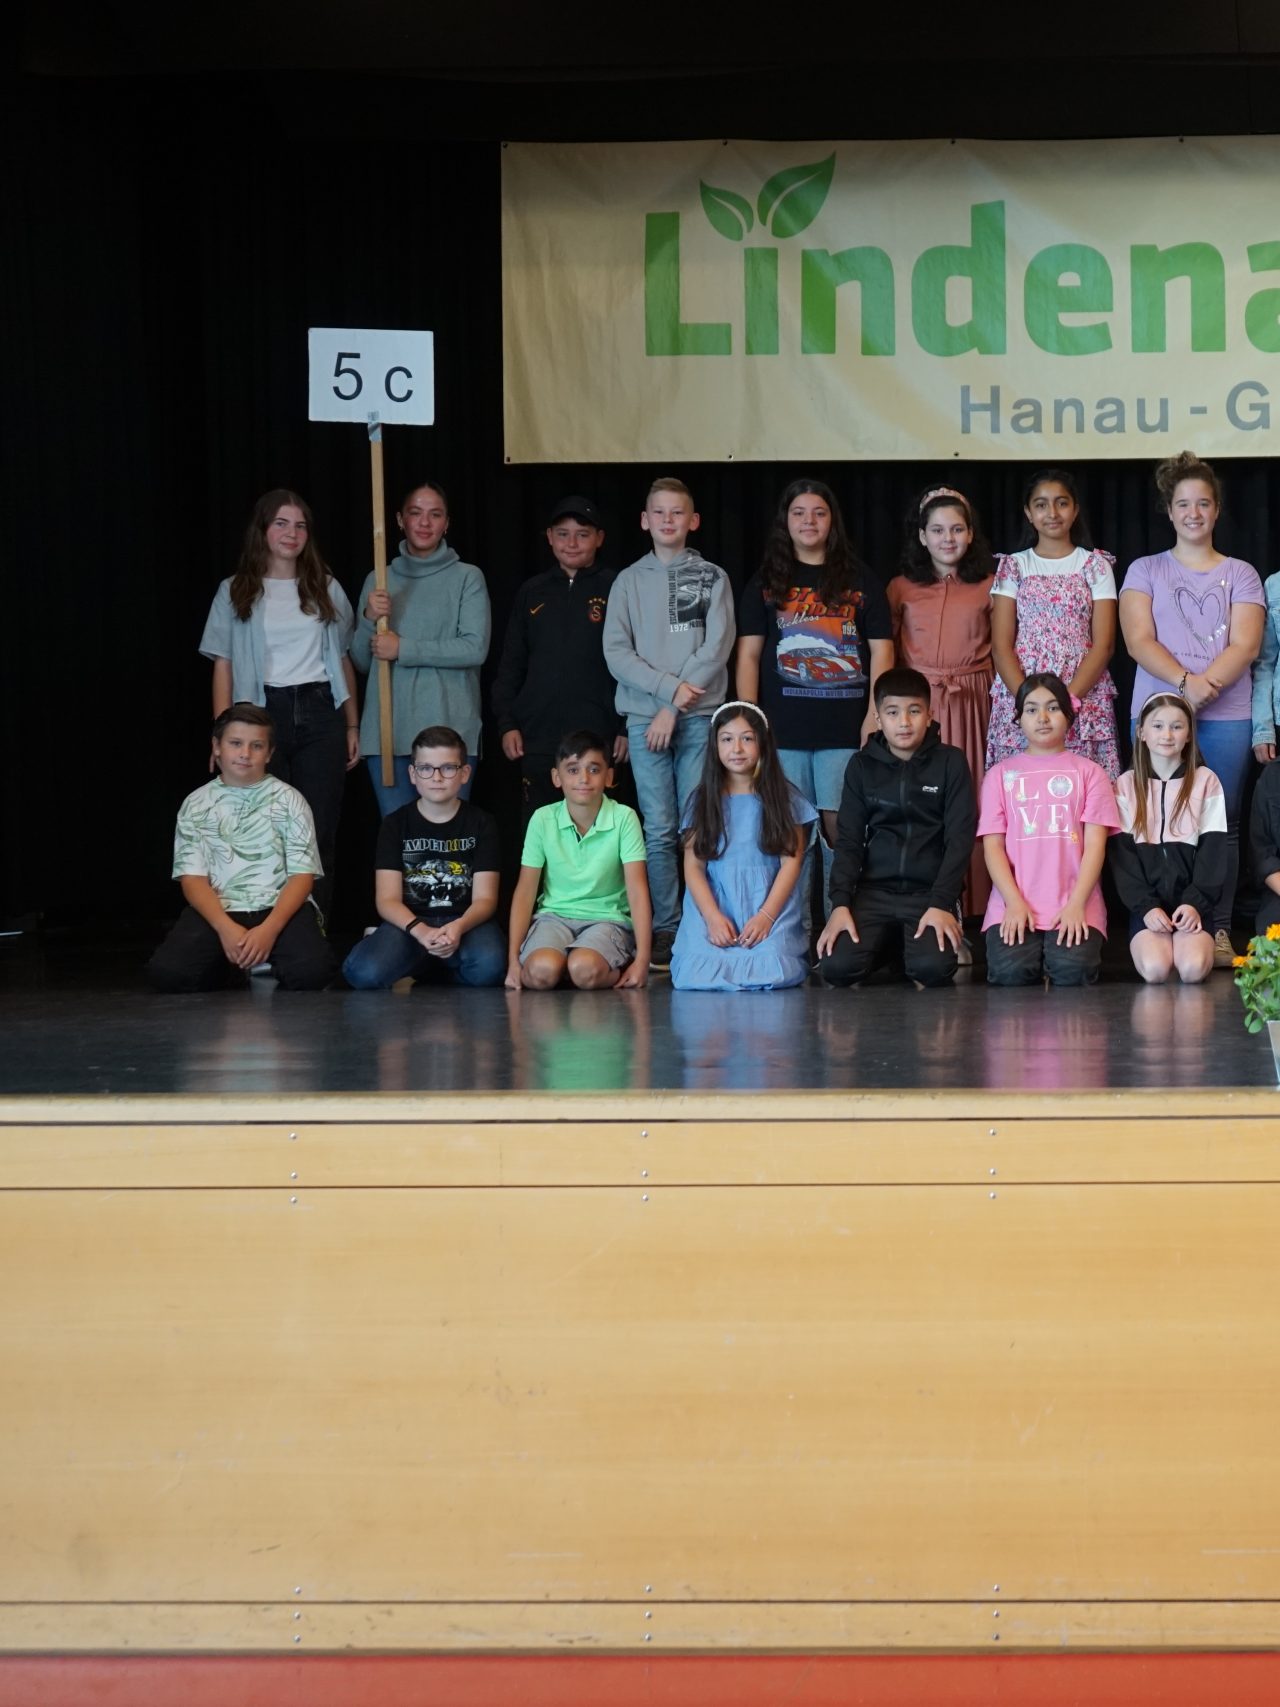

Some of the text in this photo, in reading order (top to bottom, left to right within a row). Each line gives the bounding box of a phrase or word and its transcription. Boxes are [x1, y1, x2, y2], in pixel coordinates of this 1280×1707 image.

[332, 352, 414, 403] 5 c
[960, 384, 1170, 434] Hanau
[670, 623, 689, 633] 1972
